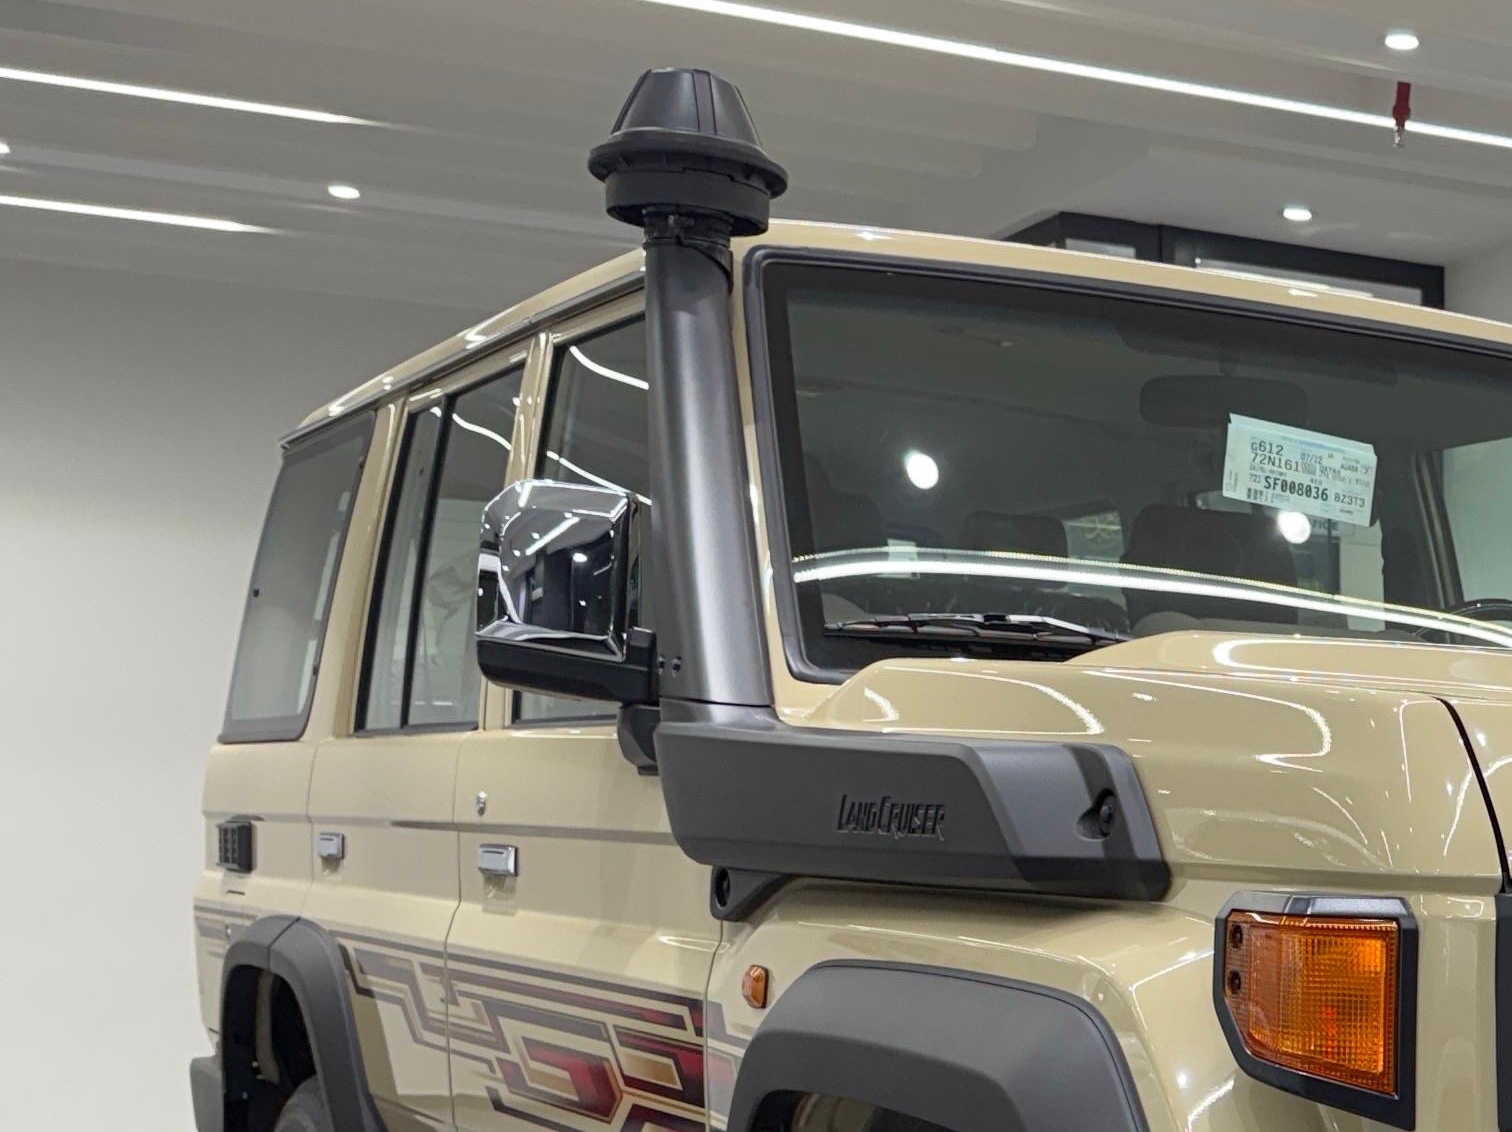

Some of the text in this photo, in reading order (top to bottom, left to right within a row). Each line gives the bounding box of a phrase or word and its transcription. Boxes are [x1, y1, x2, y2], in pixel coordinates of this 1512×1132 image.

[1251, 441, 1284, 456] G612
[1251, 452, 1300, 472] 72N161
[1264, 475, 1329, 502] SF008036
